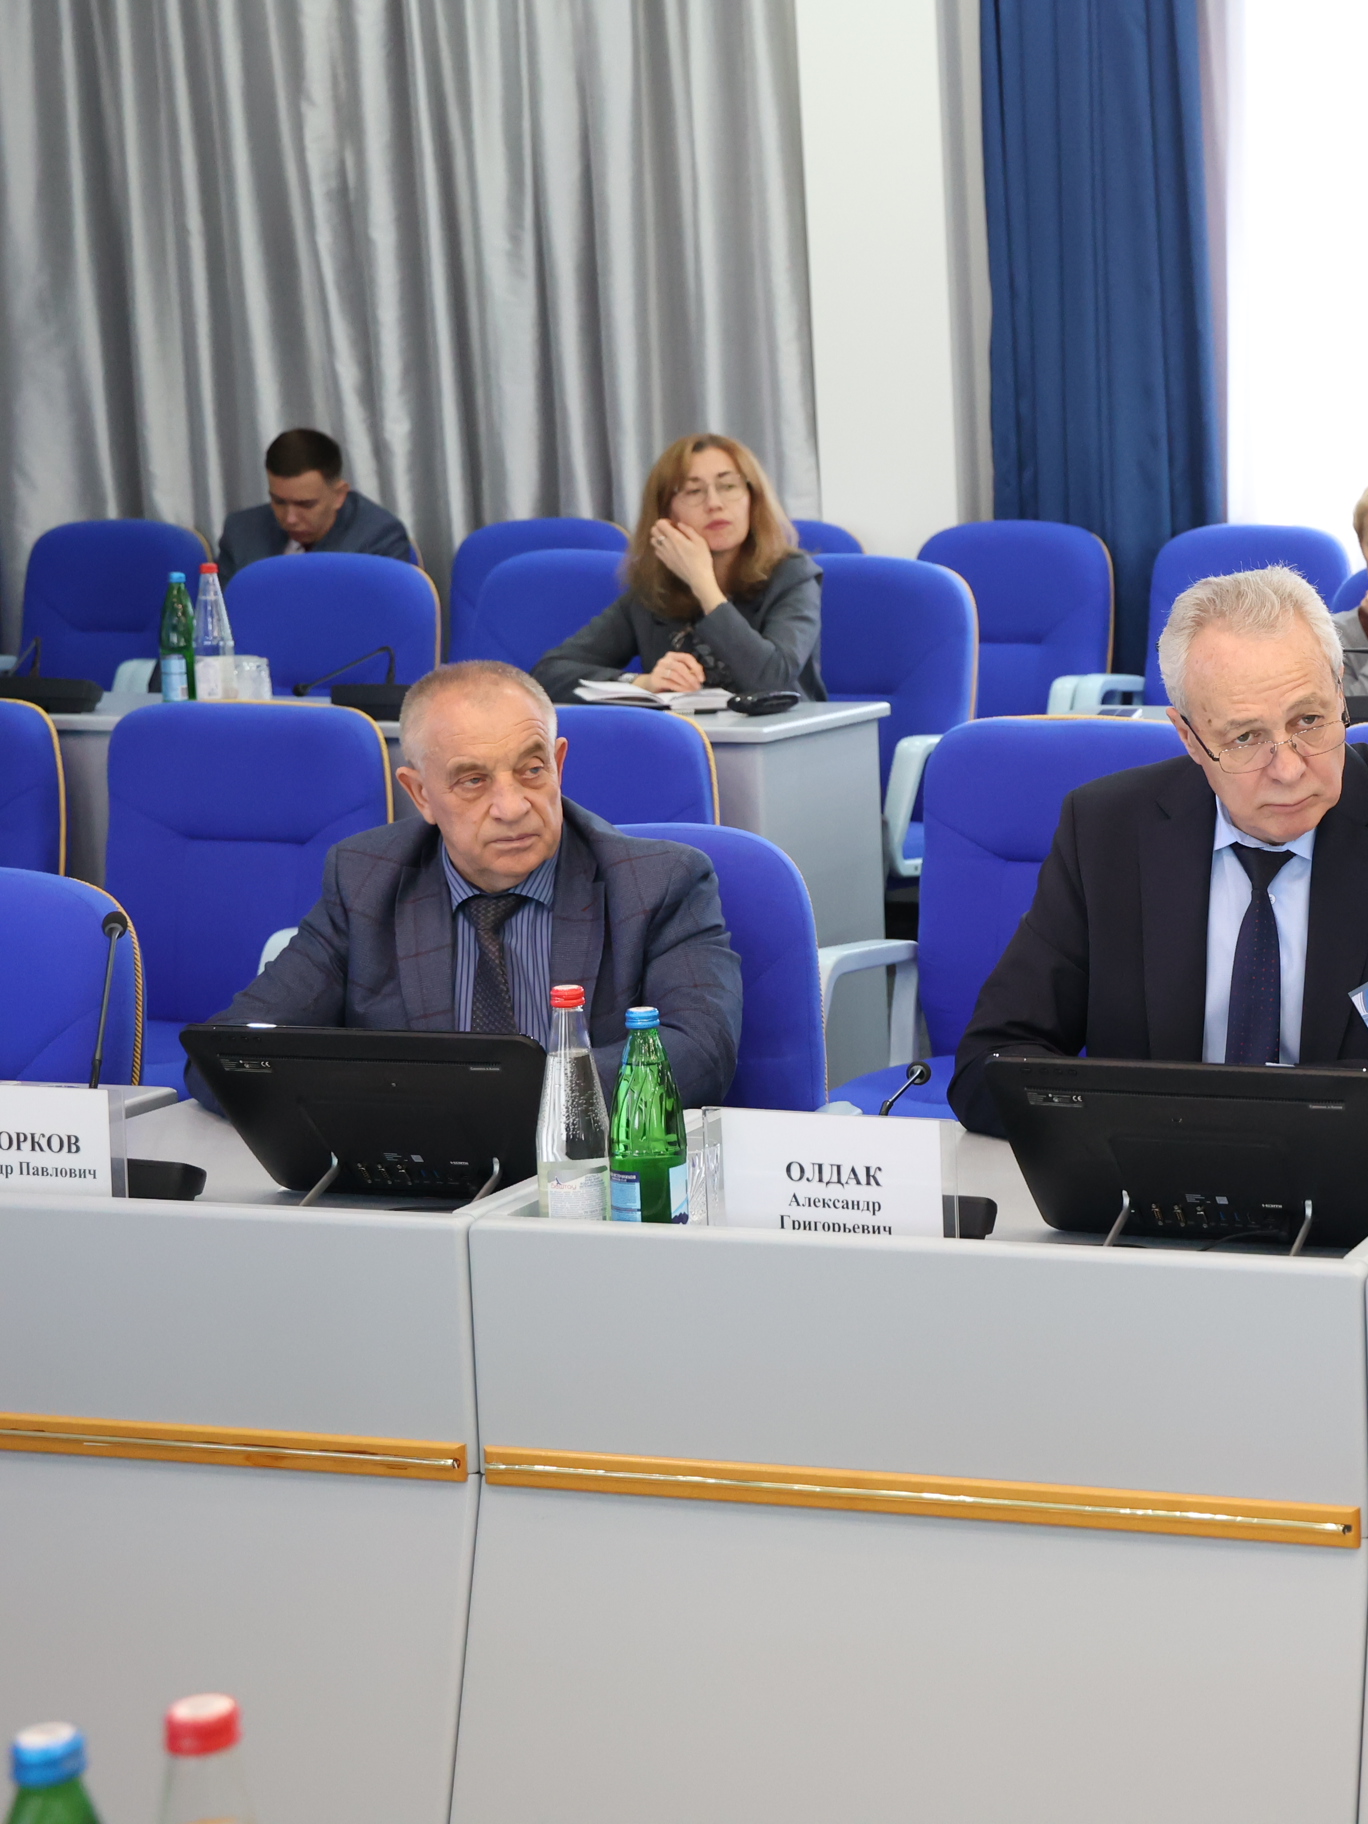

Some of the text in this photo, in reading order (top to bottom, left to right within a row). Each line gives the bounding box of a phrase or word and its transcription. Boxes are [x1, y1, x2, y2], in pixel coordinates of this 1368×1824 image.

[0, 1131, 81, 1154] ОРКОВ
[19, 1161, 97, 1180] Павлович
[785, 1160, 883, 1189] ОЛДАК
[788, 1192, 882, 1216] Александр
[779, 1214, 892, 1235] Григорьевич
